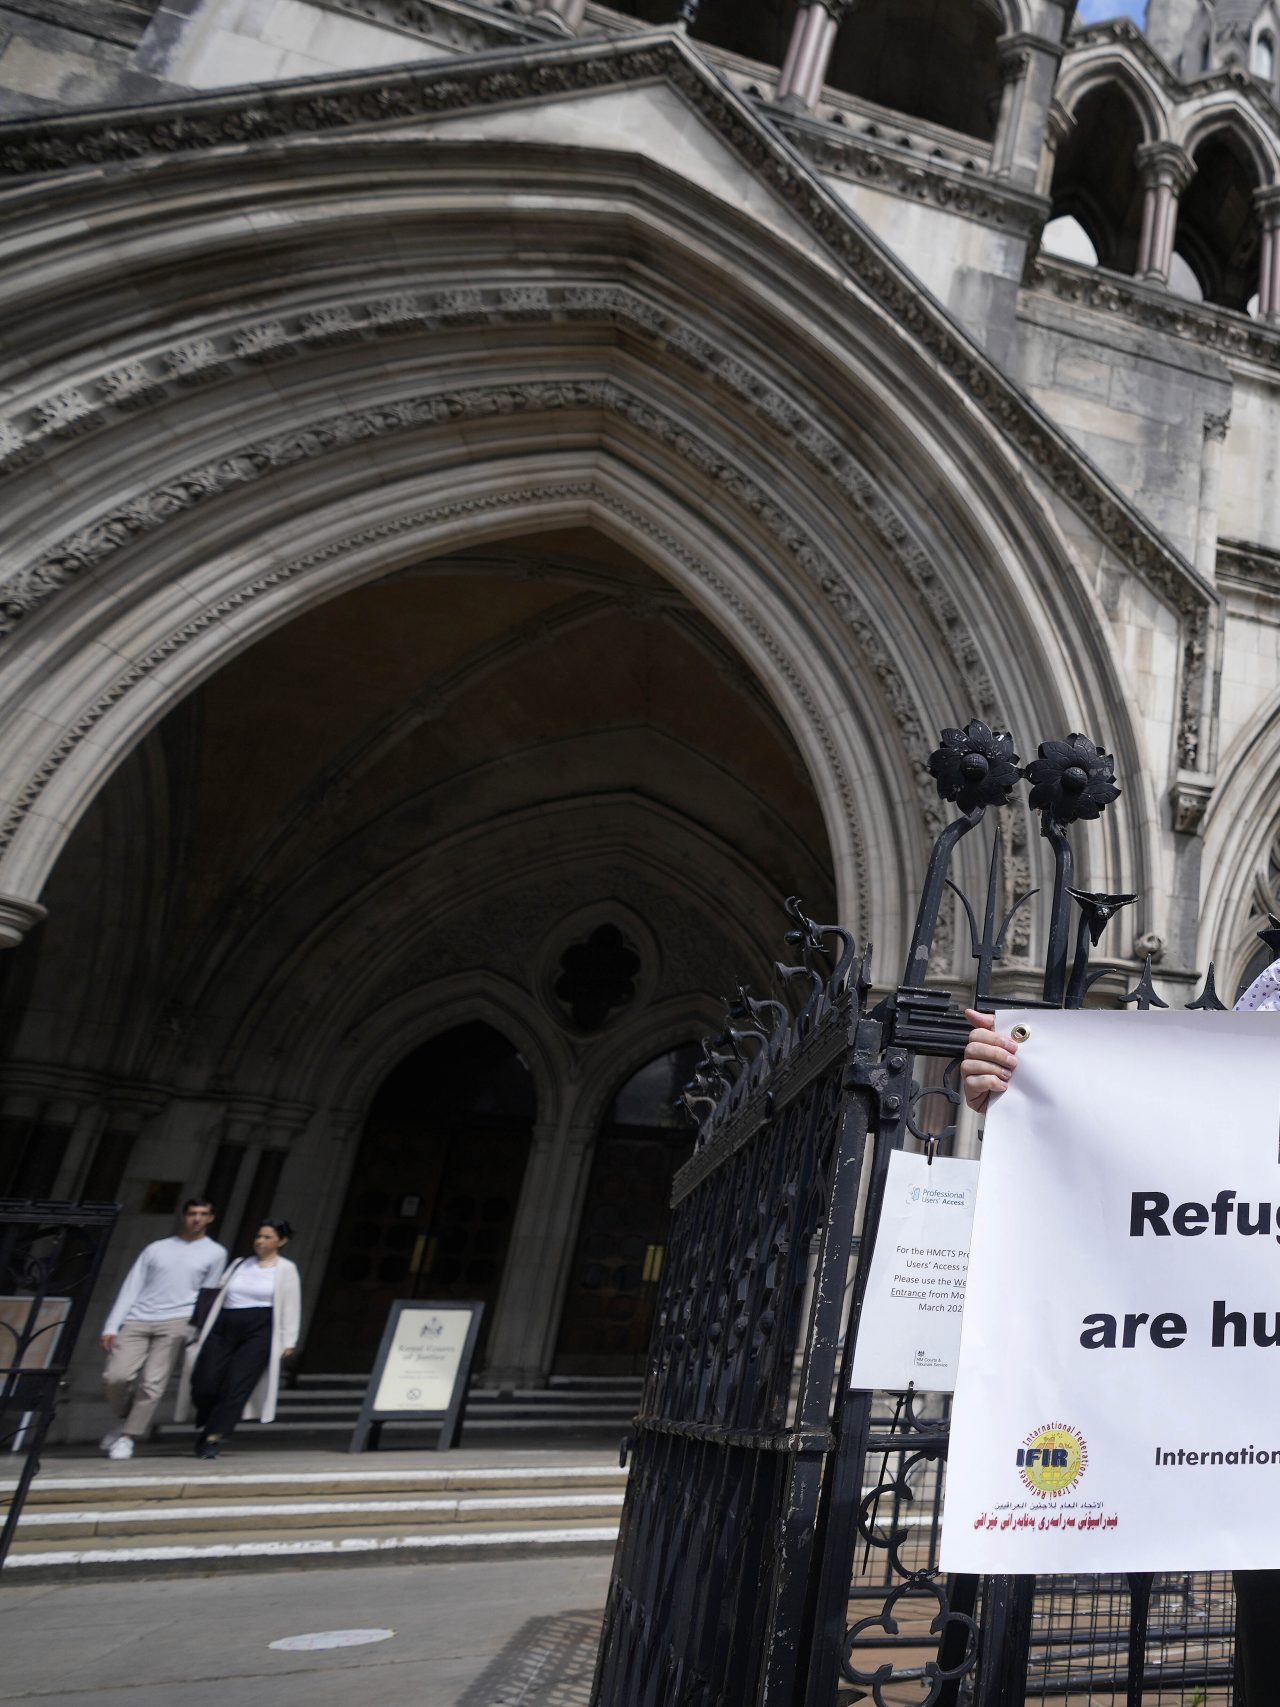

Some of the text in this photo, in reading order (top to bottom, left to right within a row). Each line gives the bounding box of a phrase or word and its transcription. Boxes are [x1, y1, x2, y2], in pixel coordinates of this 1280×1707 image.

[922, 1188, 965, 1199] Professional
[941, 1198, 965, 1206] Access
[896, 1246, 909, 1254] For
[911, 1247, 924, 1255] the
[926, 1249, 956, 1258] HMCTS
[906, 1260, 931, 1269] Users'
[932, 1262, 960, 1271] Access
[894, 1274, 920, 1284] Please
[938, 1277, 952, 1286] the
[890, 1287, 965, 1300] Entrance from Mo
[918, 1303, 945, 1312] March
[1079, 1313, 1188, 1350] are
[1015, 1448, 1069, 1468] IFIR
[1074, 1431, 1088, 1477] Federation
[1019, 1469, 1047, 1500] Refugees
[1071, 1478, 1079, 1490] of
[1049, 1486, 1071, 1500] Iraqi
